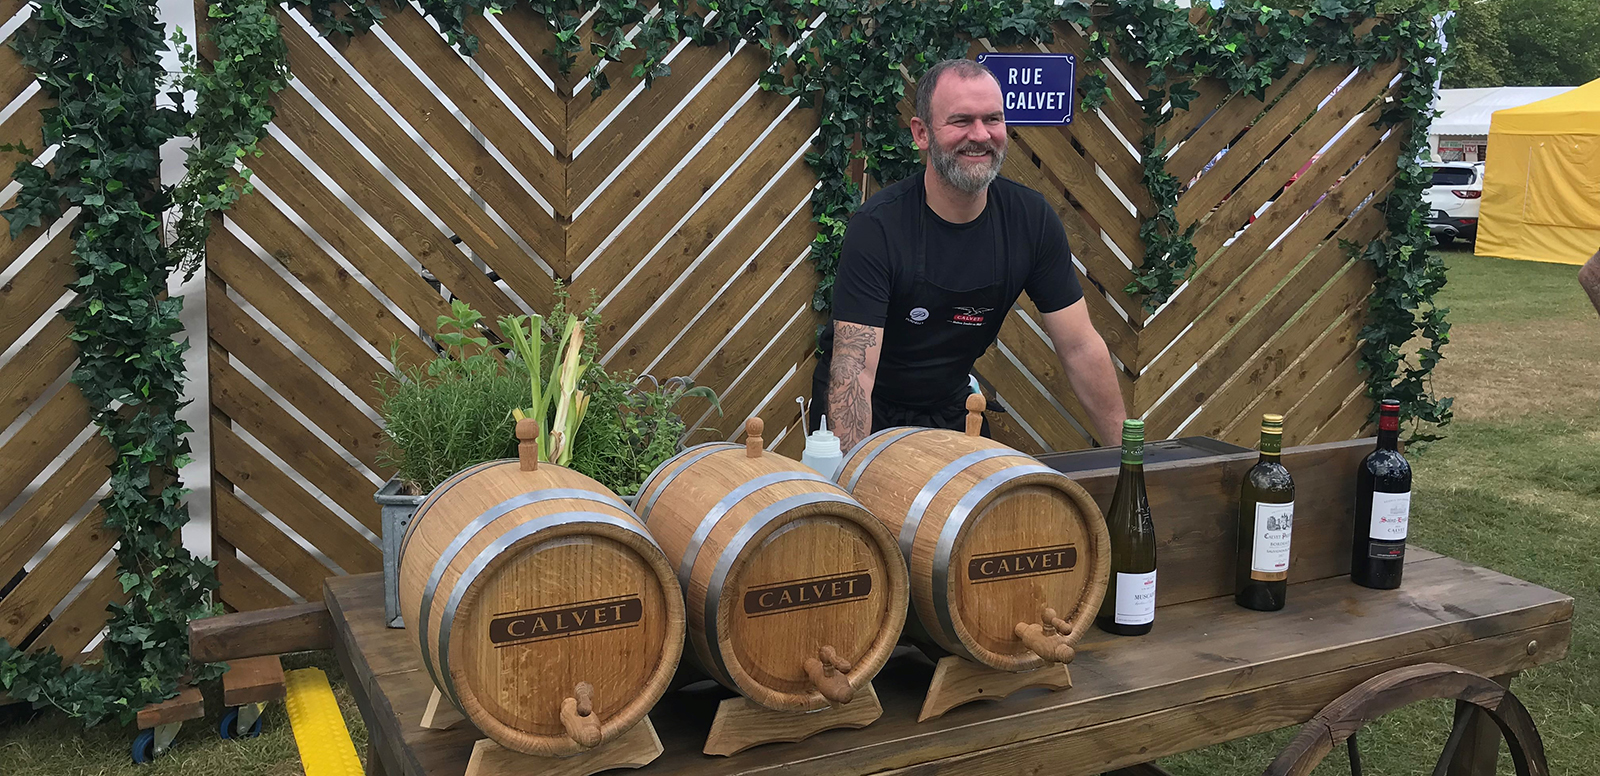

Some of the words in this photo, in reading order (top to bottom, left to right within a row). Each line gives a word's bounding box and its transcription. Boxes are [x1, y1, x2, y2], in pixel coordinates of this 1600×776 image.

[1008, 68, 1042, 85] RUE
[1006, 92, 1065, 109] CALVET
[980, 551, 1066, 576] CALVET
[758, 579, 858, 608] CALVET
[507, 604, 626, 637] CALVET
